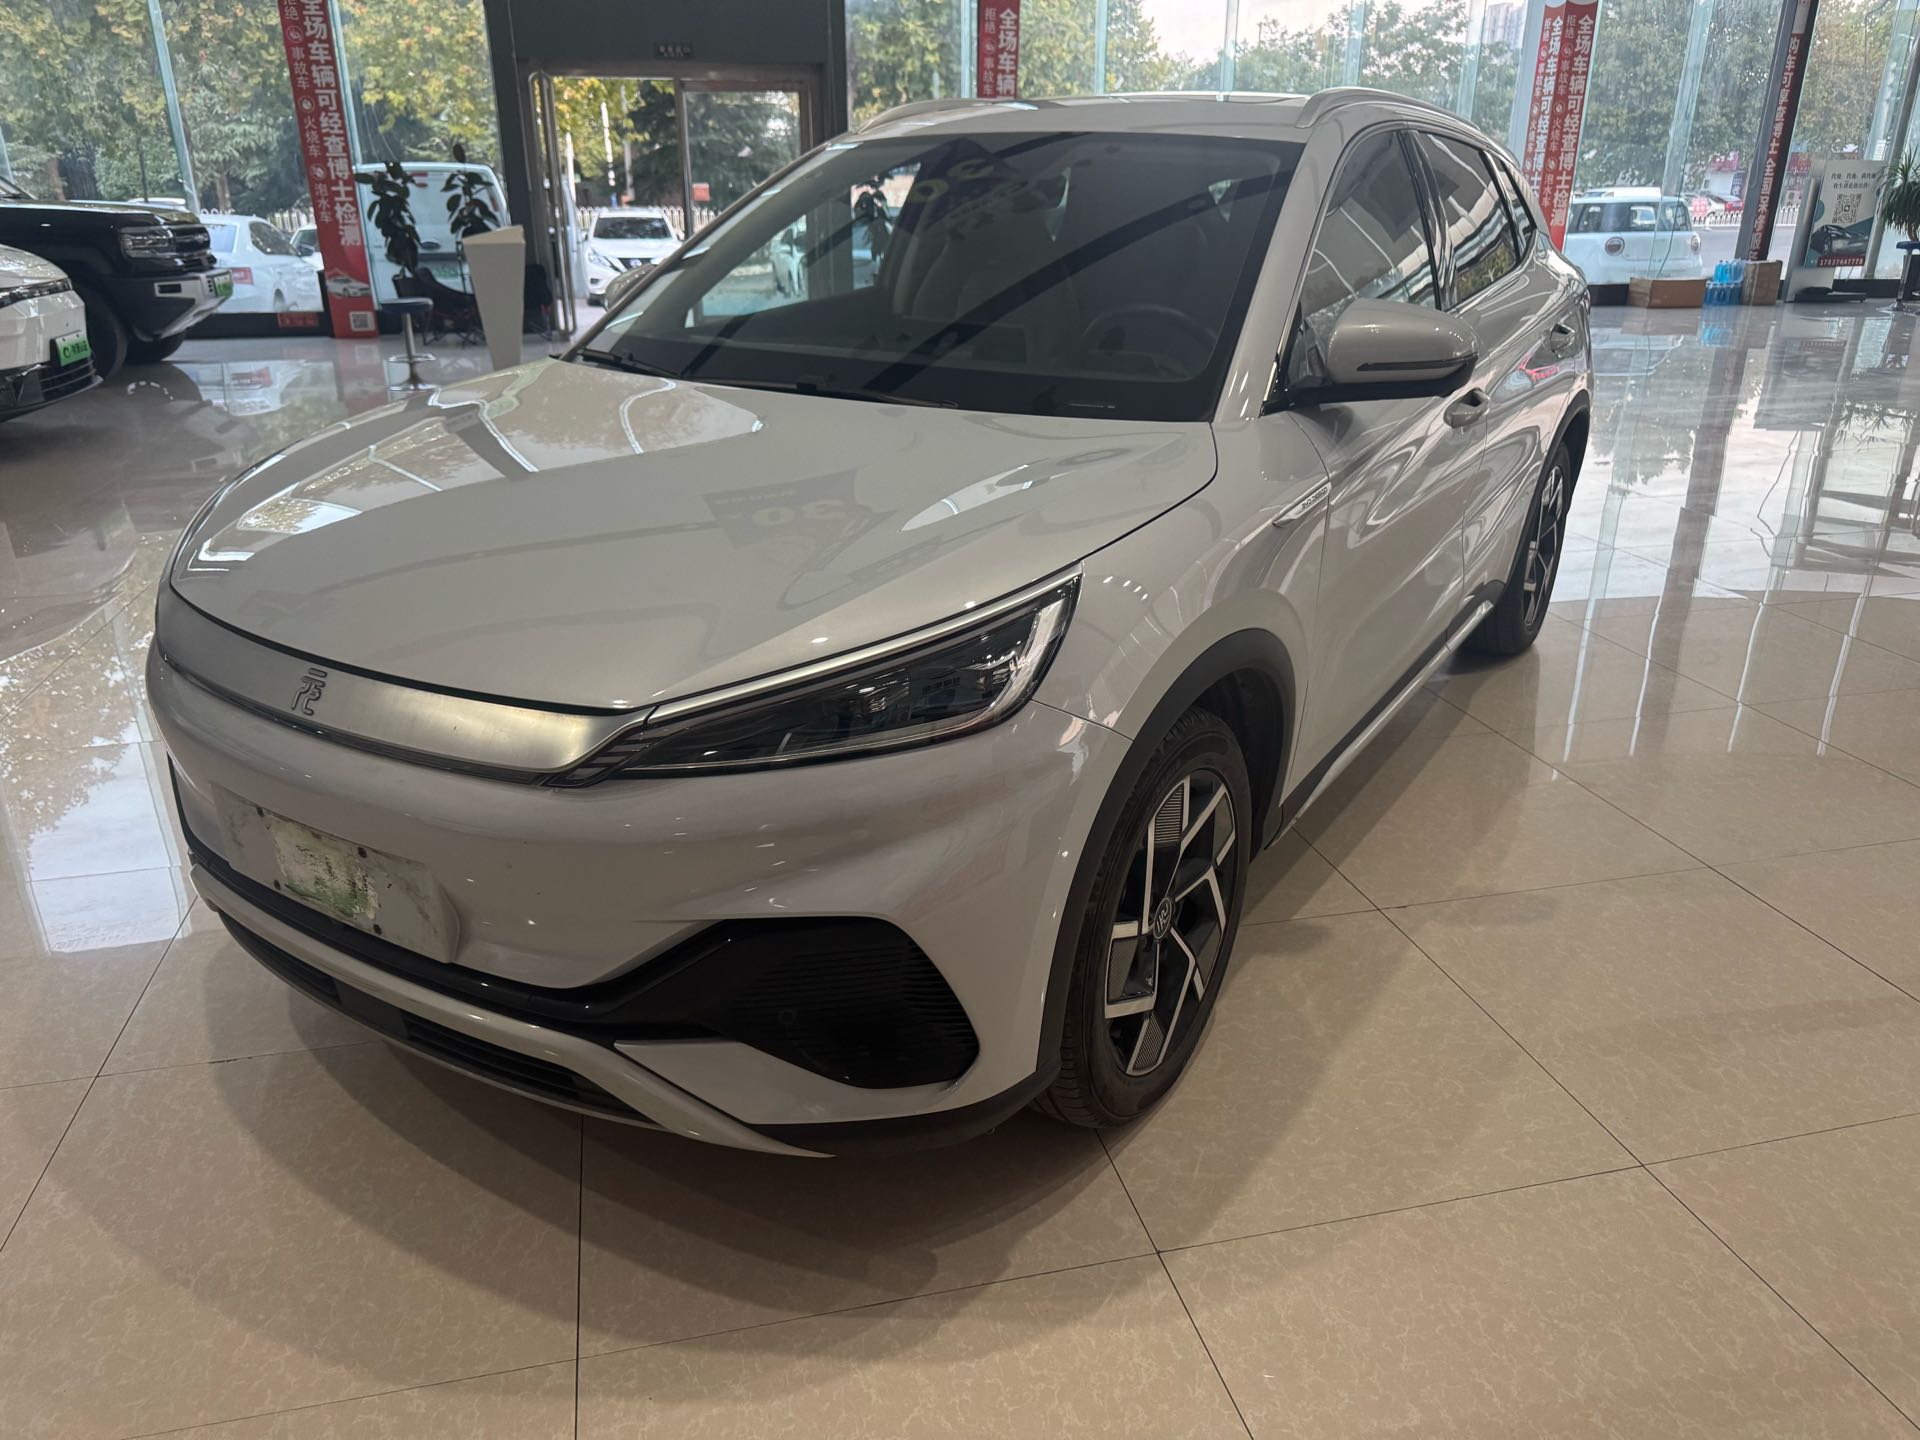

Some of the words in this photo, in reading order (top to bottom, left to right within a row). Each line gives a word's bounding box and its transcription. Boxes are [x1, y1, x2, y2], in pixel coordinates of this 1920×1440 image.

[284, 0, 300, 20] 绝
[996, 8, 1018, 99] 全场车辆
[1549, 15, 1594, 226] 全场车辆可经查博士检测
